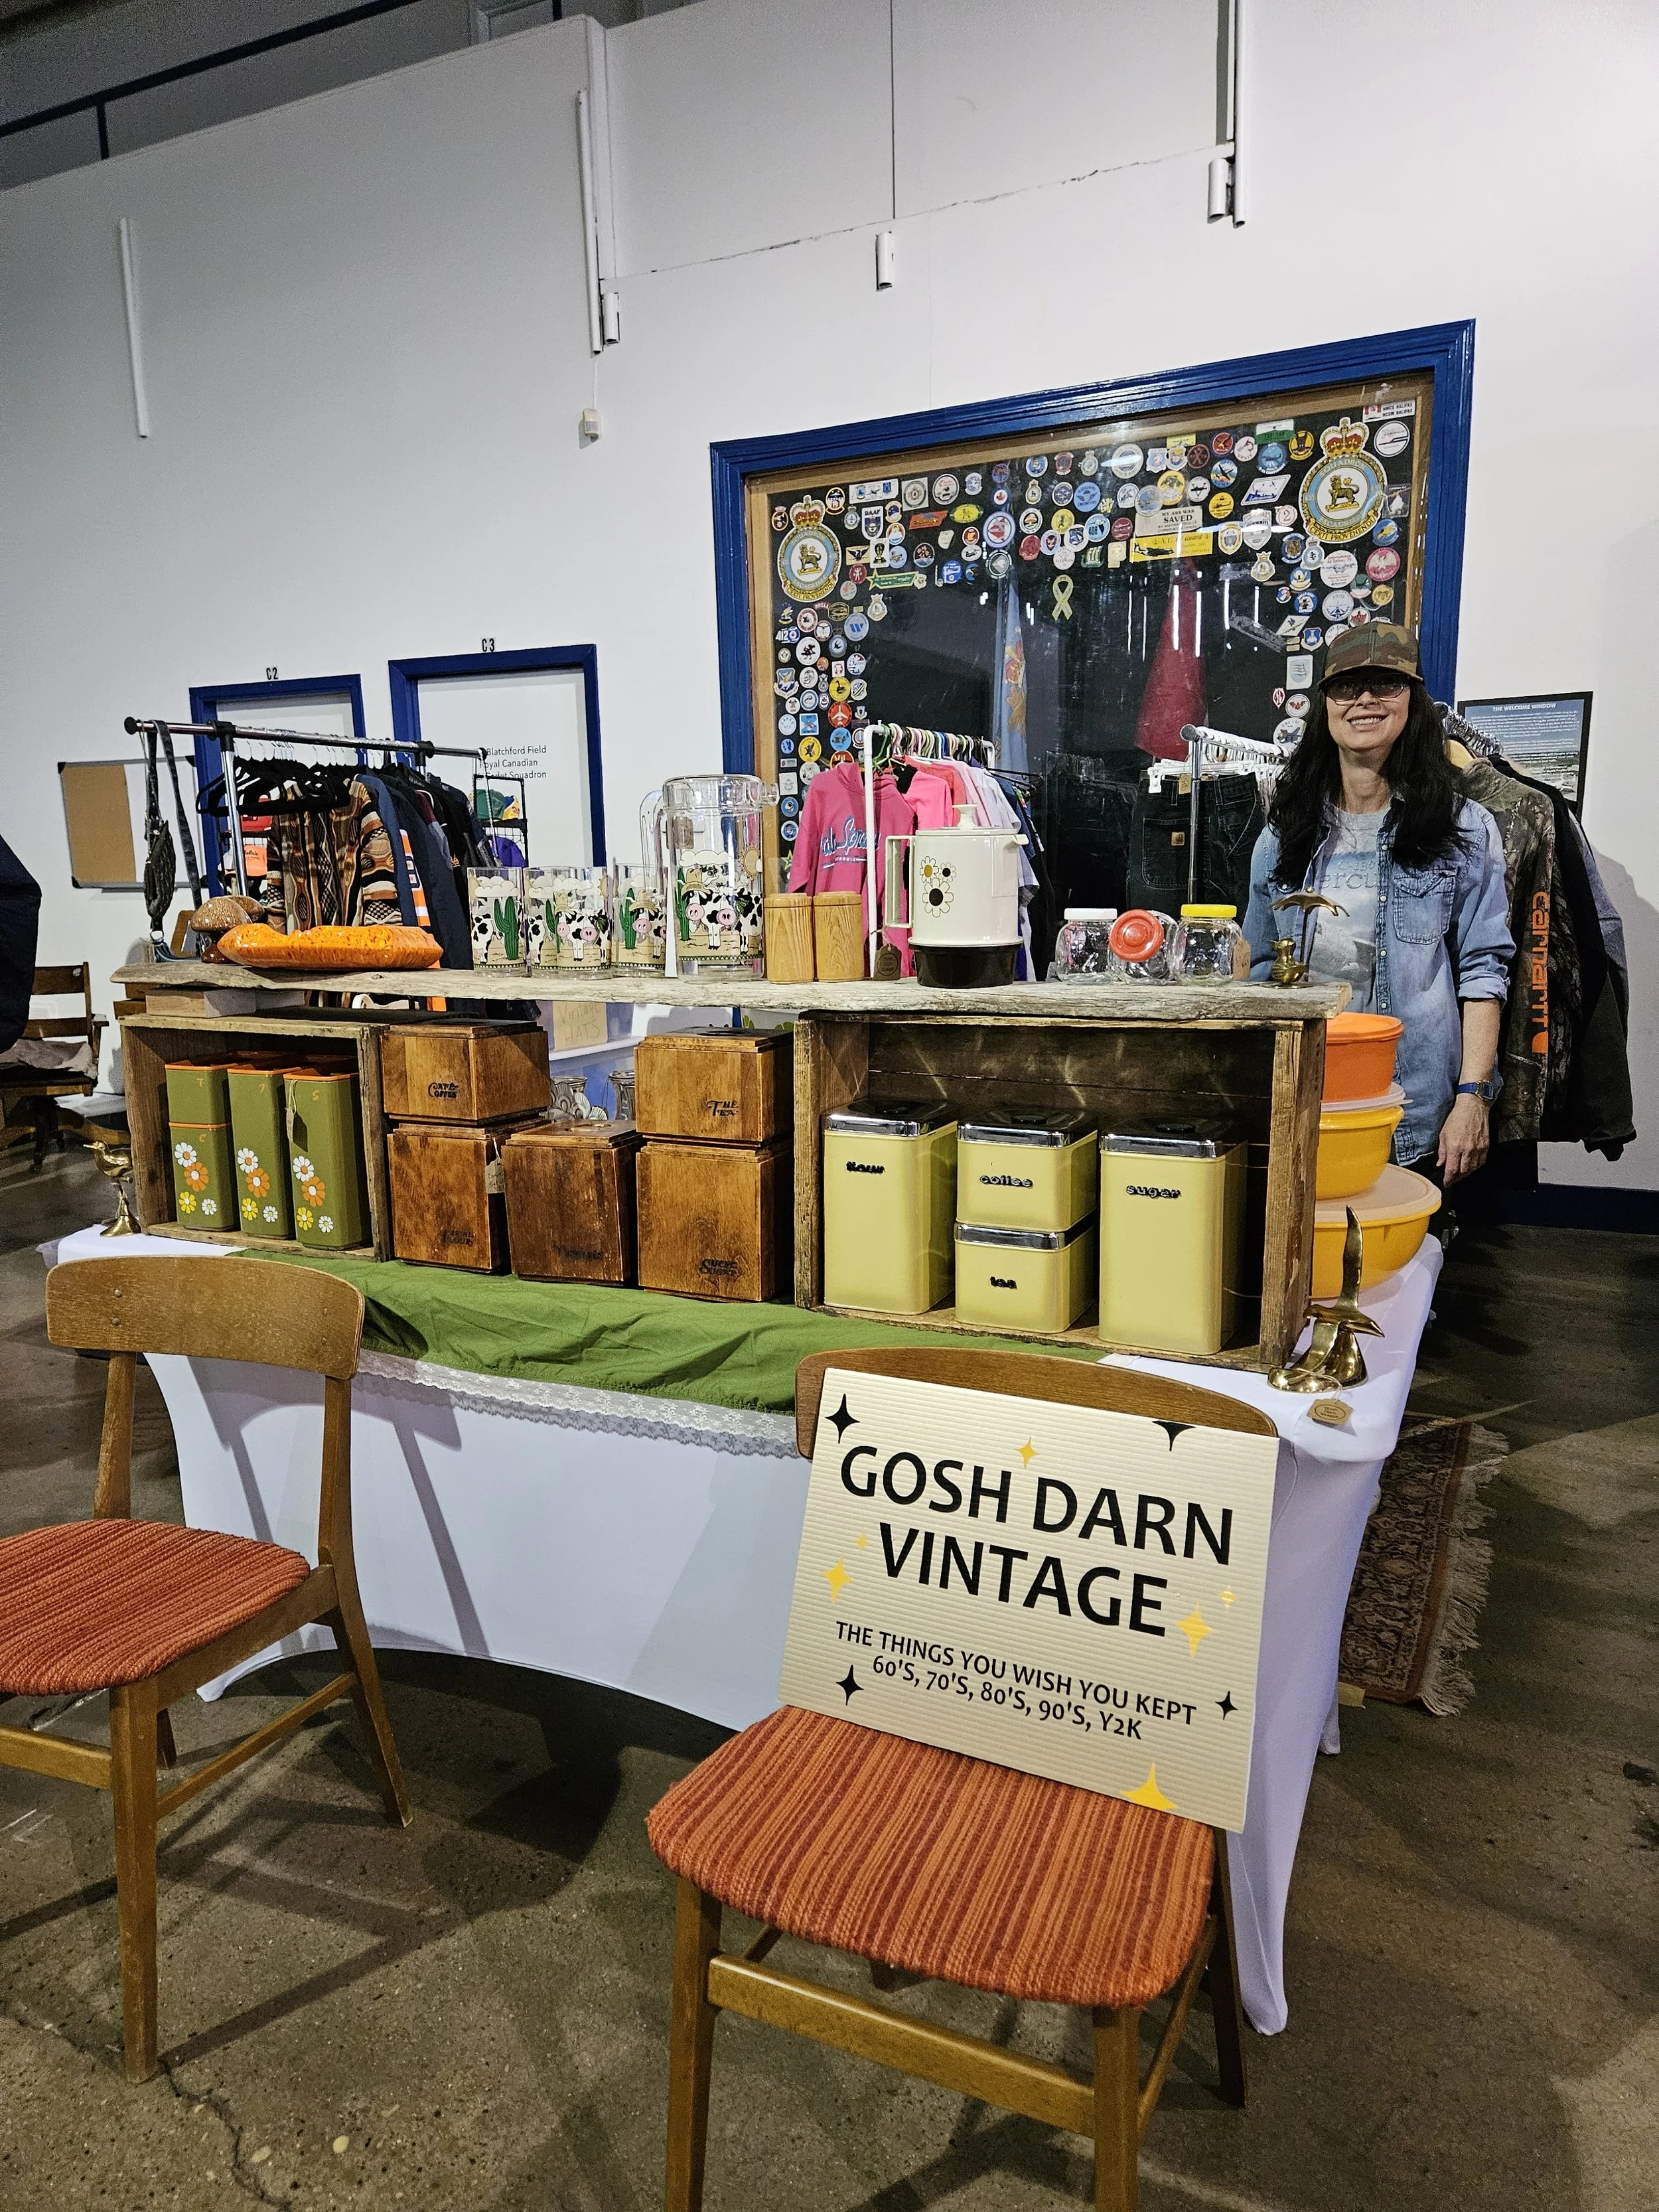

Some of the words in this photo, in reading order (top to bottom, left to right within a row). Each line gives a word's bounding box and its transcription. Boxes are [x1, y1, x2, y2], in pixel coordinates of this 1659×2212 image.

[1163, 514, 1192, 524] SAVED
[1283, 509, 1291, 522] 2
[1310, 526, 1329, 540] CERTI
[1331, 520, 1374, 540] PROVEHENDI
[776, 630, 788, 642] 412
[482, 638, 495, 652] C3
[266, 667, 279, 680] C2
[486, 745, 526, 756] Blatchford
[528, 745, 547, 754] Field
[502, 758, 538, 767] Canadian
[1338, 860, 1376, 871] C-130
[1321, 872, 1378, 889] ercu
[565, 1021, 601, 1043] HATS
[979, 1175, 1033, 1188] coffee
[1126, 1185, 1181, 1199] sugar
[989, 1276, 1017, 1289] tea
[841, 1445, 1013, 1524] GOSH
[1032, 1477, 1234, 1566] DARN
[879, 1522, 1169, 1637] VINTAGE
[835, 1621, 873, 1647] THE
[879, 1631, 954, 1666] THINGS
[960, 1651, 1007, 1679] YOU
[1013, 1663, 1072, 1696] WISH
[1079, 1679, 1128, 1709] YOU
[1135, 1693, 1197, 1725] KEPT
[873, 1655, 920, 1688] 60'S,
[926, 1670, 974, 1702] 70'S,
[980, 1681, 1032, 1717] 80'S,
[1039, 1700, 1092, 1732] 90'S,
[1099, 1710, 1143, 1740] Y2K
